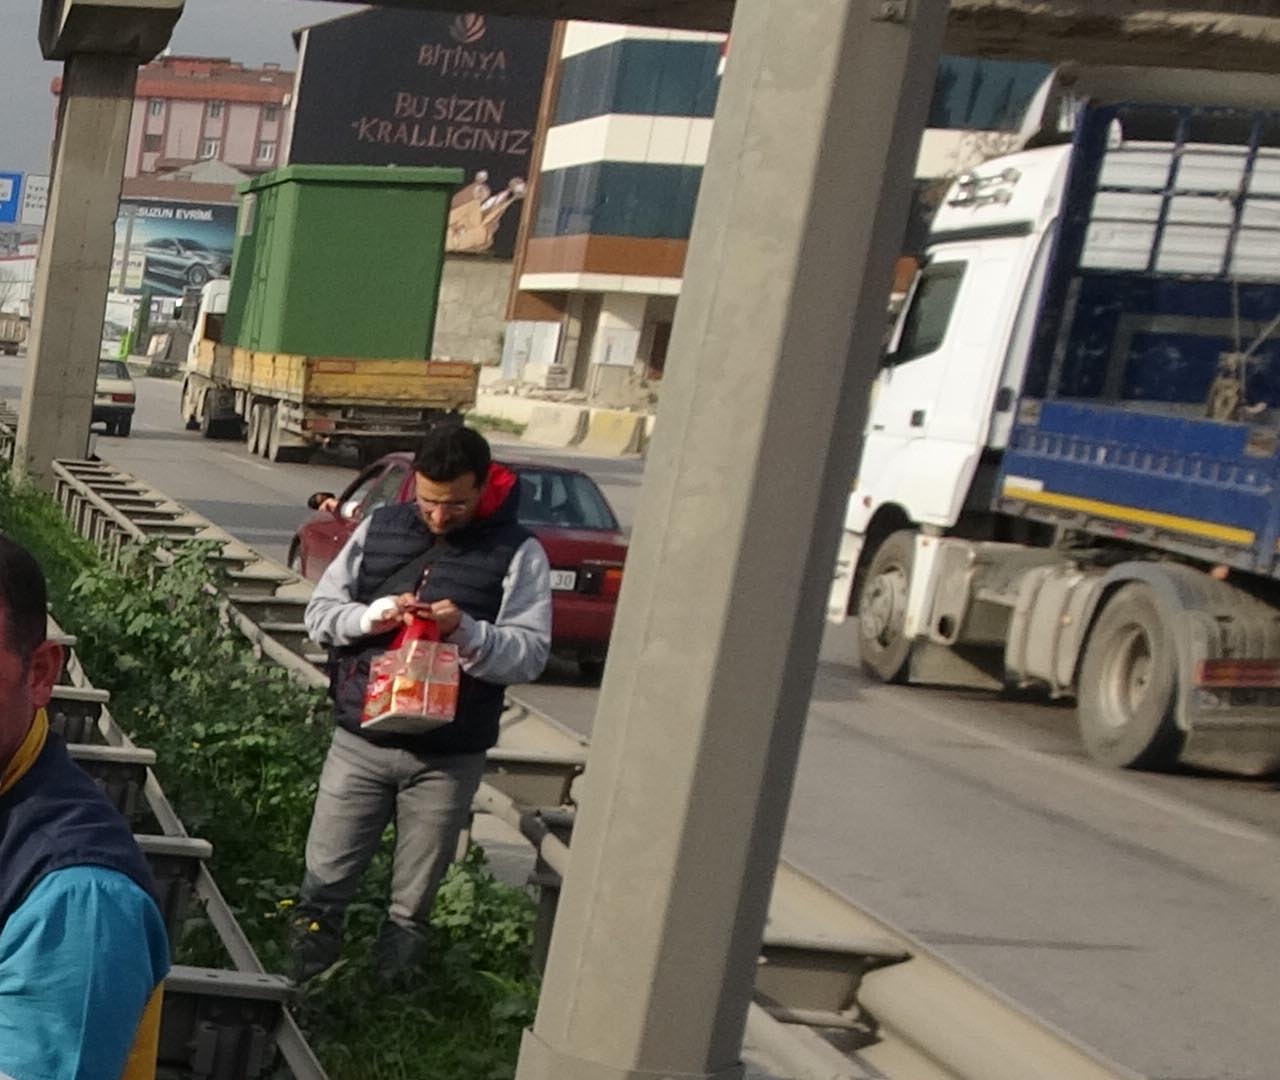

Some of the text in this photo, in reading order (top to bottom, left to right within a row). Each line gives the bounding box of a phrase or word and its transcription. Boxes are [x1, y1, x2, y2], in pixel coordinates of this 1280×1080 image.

[394, 92, 506, 123] BU SİZİN
[555, 574, 574, 588] 30
